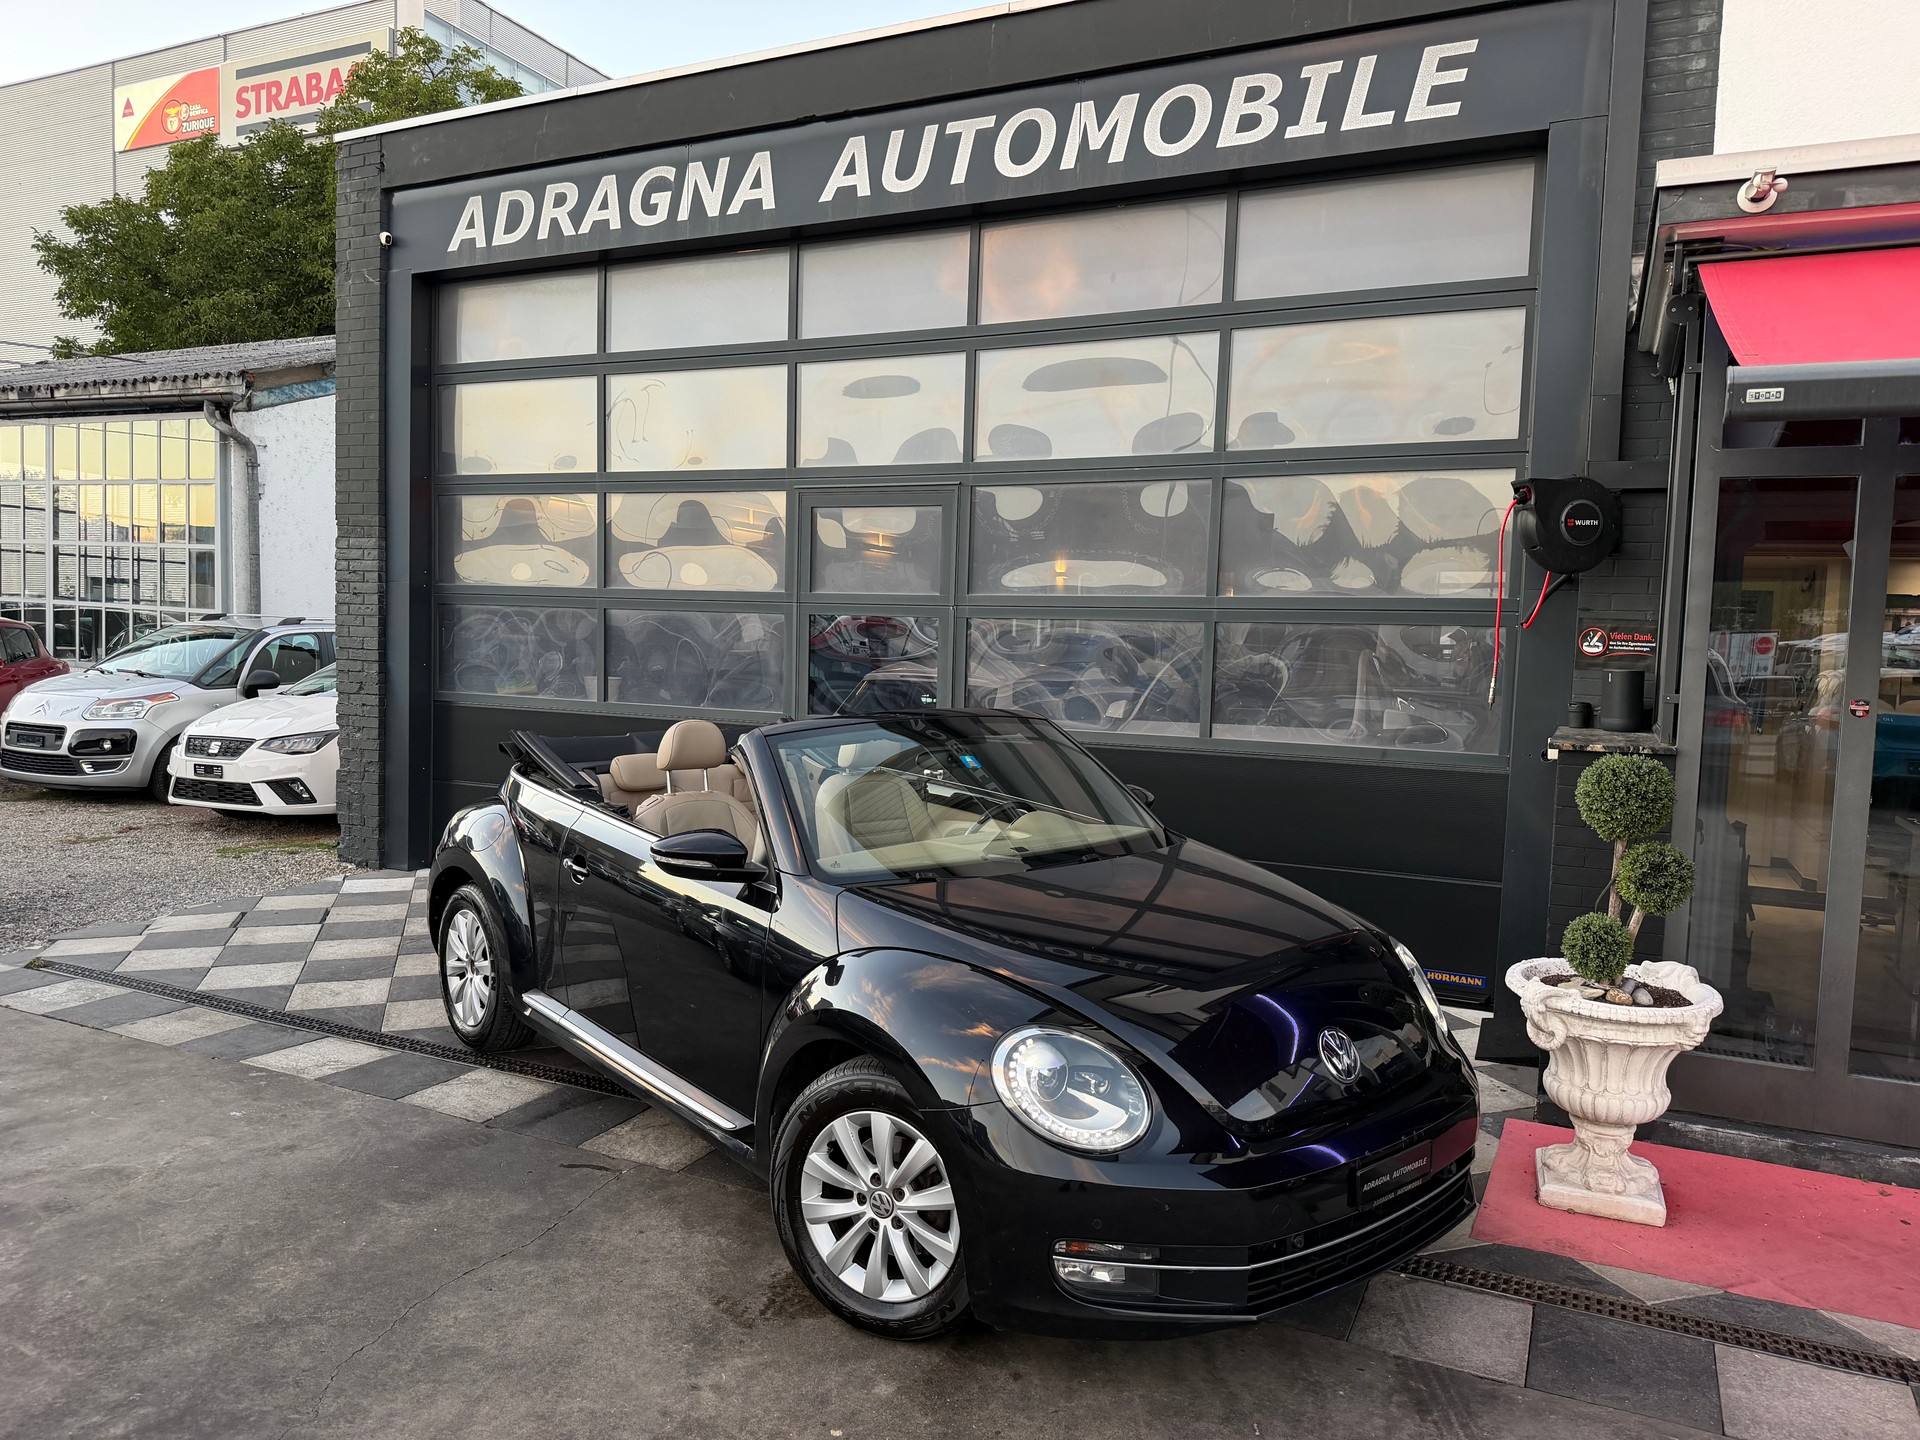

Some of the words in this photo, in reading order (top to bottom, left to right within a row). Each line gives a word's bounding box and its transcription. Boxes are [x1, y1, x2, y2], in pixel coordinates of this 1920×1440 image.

[181, 117, 215, 133] ZURIQUE
[446, 150, 776, 253] ADRAGNA
[817, 38, 1480, 204] AUTOMOBILE
[1750, 391, 1782, 400] STOBAG
[1609, 632, 1633, 640] Vielen
[1634, 633, 1655, 642] Dank,
[1427, 971, 1482, 986] HÖRMANN
[1362, 1174, 1390, 1192] ADRAGNA
[1392, 1156, 1428, 1179] AUTOMOBILE
